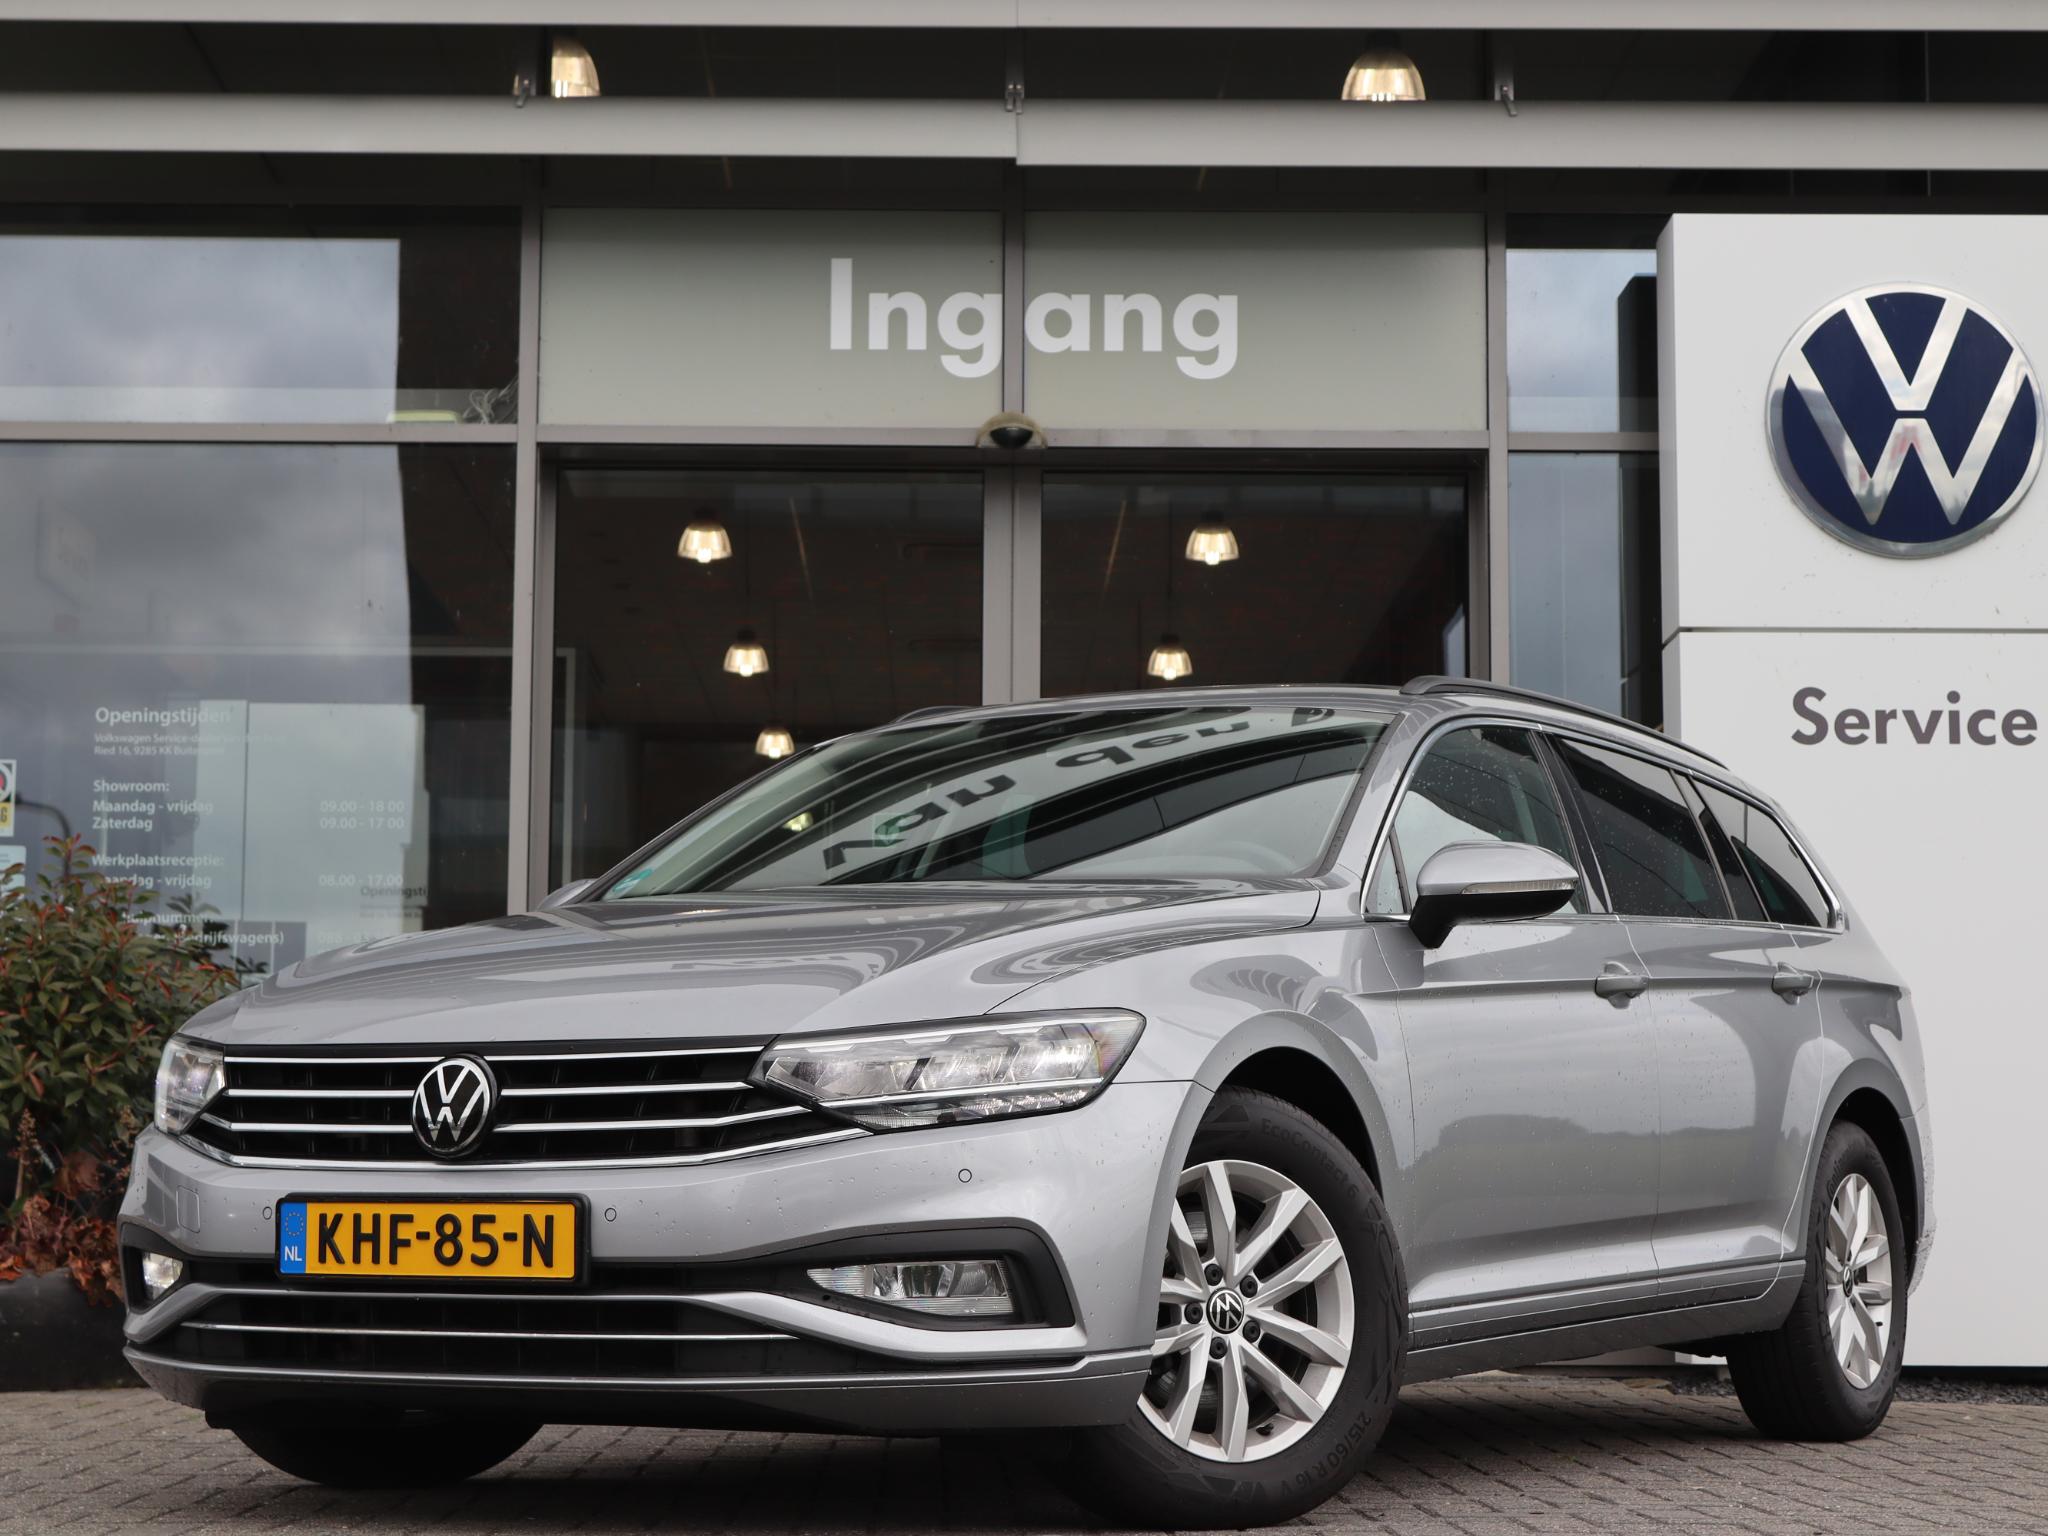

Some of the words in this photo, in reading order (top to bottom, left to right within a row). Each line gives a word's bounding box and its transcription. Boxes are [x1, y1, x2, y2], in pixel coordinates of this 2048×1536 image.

[830, 258, 1238, 379] Ingang
[95, 707, 231, 726] Openingstijden
[1790, 686, 2038, 747] Service
[93, 780, 170, 793] Showroom:
[92, 800, 155, 815] Maandag
[166, 800, 213, 815] vrijdag
[320, 800, 357, 812] 09.00
[92, 817, 153, 832] Zaterdag
[320, 817, 357, 829] 09.00
[92, 854, 224, 870] Werkplaatsreceptie:
[103, 874, 154, 889] aandag
[165, 873, 212, 889] vrijdag
[319, 874, 356, 886] 08.00
[367, 874, 404, 886] 17.00
[1261, 1117, 1349, 1185] EcoContact
[1347, 1183, 1360, 1200] 6
[317, 1212, 555, 1268] KHF-85-N
[284, 1246, 302, 1262] NL
